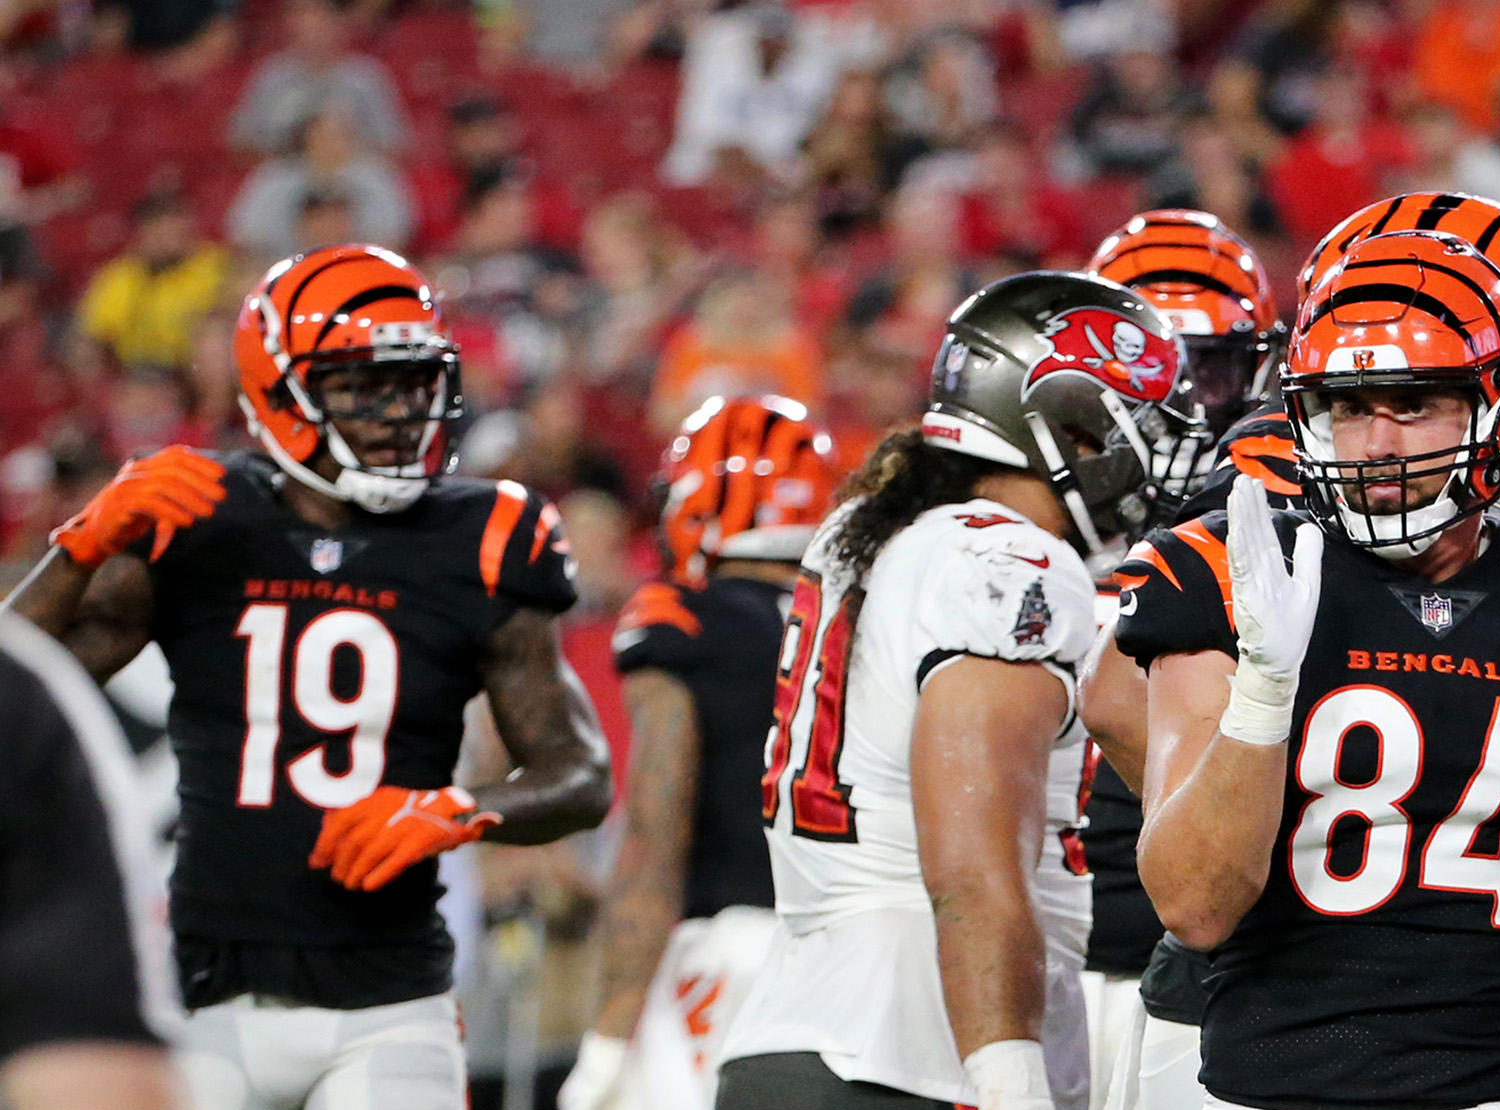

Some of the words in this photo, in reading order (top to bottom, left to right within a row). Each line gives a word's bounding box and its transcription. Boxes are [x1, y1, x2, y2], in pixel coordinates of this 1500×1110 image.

[244, 579, 397, 609] BENGALS
[1426, 608, 1449, 624] NFL
[233, 600, 400, 810] 19
